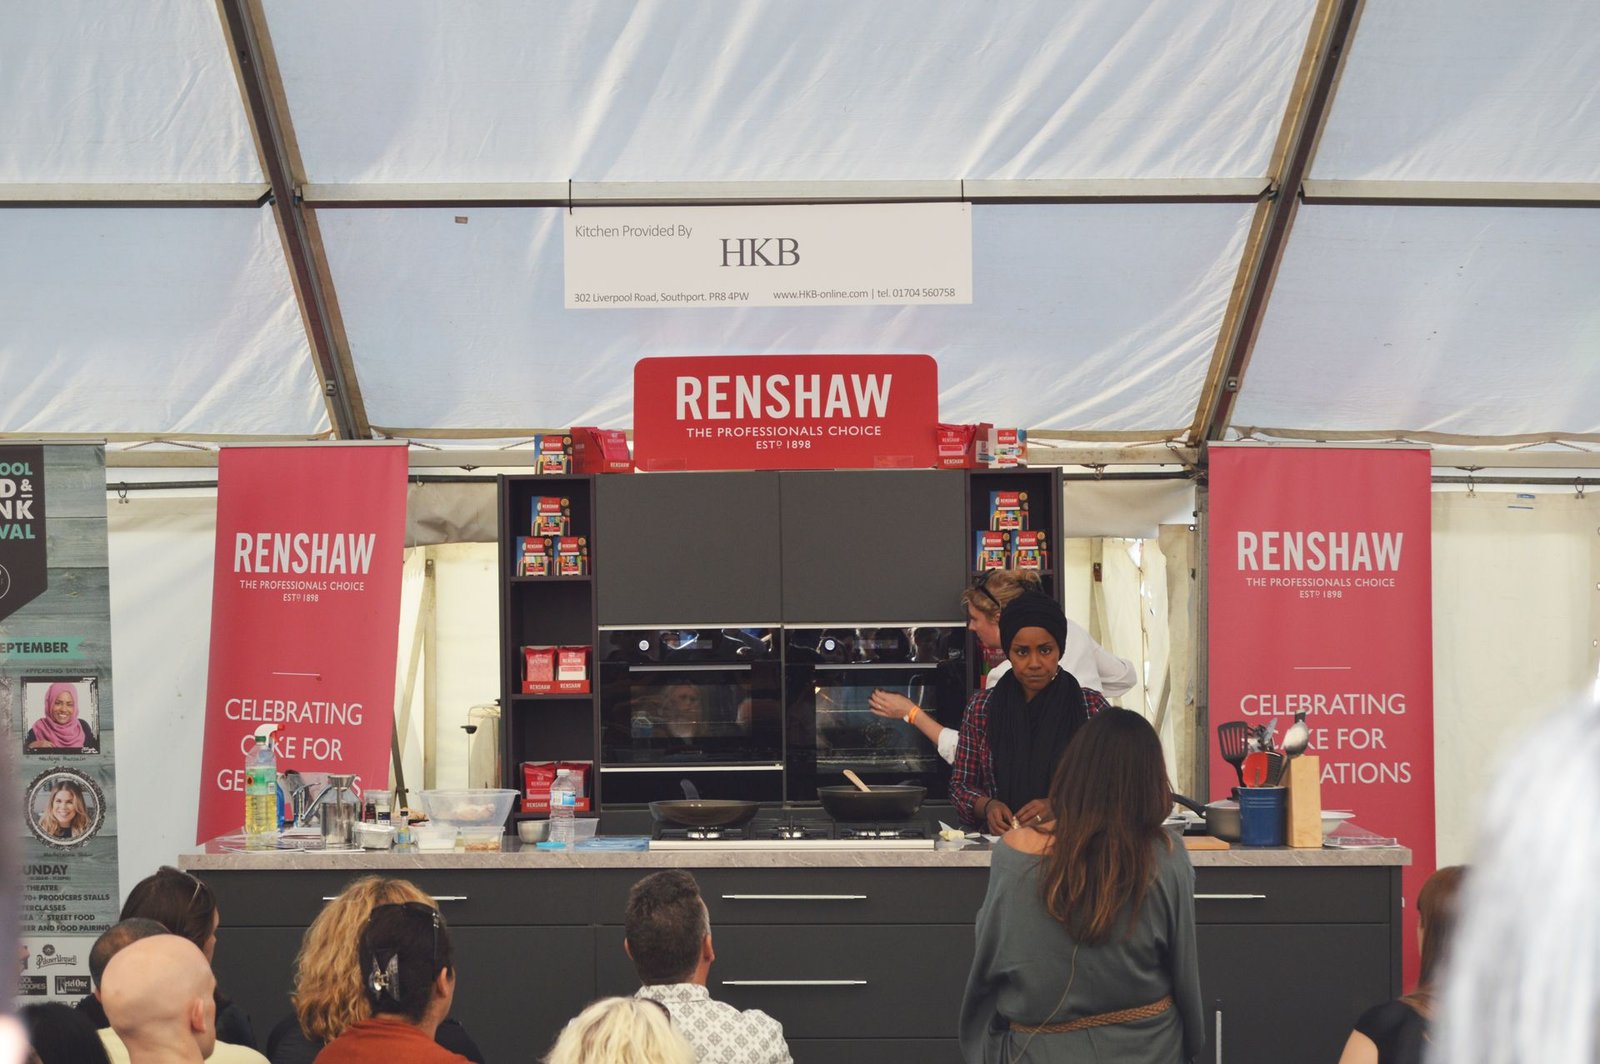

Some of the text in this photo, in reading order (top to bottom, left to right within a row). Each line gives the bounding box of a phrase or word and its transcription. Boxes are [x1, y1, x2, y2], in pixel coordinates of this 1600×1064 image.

[574, 223, 693, 240] Kitchen Provided By
[719, 237, 801, 268] HKB
[574, 293, 591, 303] 302
[592, 293, 633, 304] Liverpool
[634, 293, 660, 303] Road,
[708, 291, 726, 302] PR8
[727, 291, 749, 302] 4PW
[772, 288, 869, 300] www.HKB-online.com
[876, 288, 891, 299] tel.
[892, 287, 921, 299] 01704
[922, 287, 956, 299] 560758
[675, 373, 893, 421] RENSHAW
[686, 425, 882, 439] THE PROFESSIONALS CHOICE
[755, 439, 812, 450] ESTD 1898
[20, 478, 33, 492] &
[233, 532, 376, 575] RENSHAW
[1237, 530, 1404, 572] RENSHAW
[240, 579, 365, 592] THE PROFESSIONALS CHOICE
[1246, 577, 1396, 588] THE PROFESSIONALS CHOICE
[302, 593, 320, 603] 1898
[1322, 590, 1343, 599] 1898
[1239, 693, 1407, 716] CELEBRATING
[224, 698, 364, 726] CELEBRATING
[1336, 727, 1387, 750] FOR
[240, 733, 343, 761] CKE FOR
[1320, 762, 1412, 785] ATIONS
[526, 801, 549, 809] RENSHAW
[23, 864, 69, 876] UNDAY
[22, 904, 67, 912] TERCLASSES
